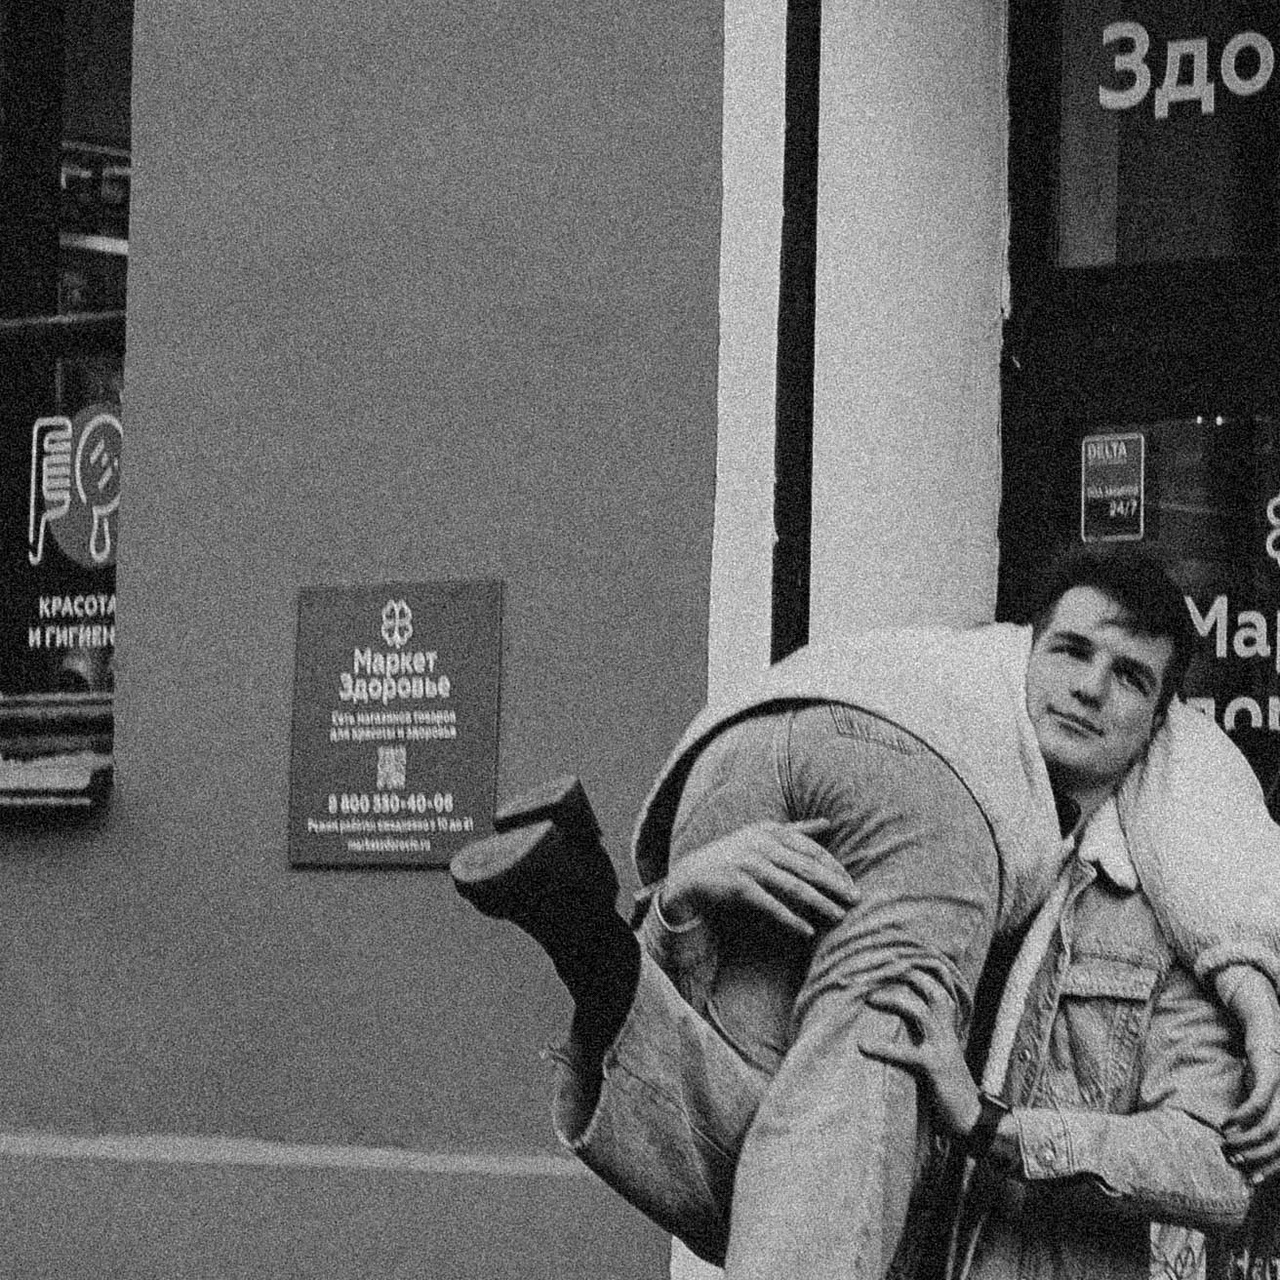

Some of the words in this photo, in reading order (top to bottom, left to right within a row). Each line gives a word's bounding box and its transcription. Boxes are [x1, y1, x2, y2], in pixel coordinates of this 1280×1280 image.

[1087, 441, 1128, 461] DELTA
[39, 593, 116, 619] КРАСОТА
[28, 626, 41, 649] И
[353, 646, 438, 677] Маркет
[339, 672, 451, 706] Здоровье
